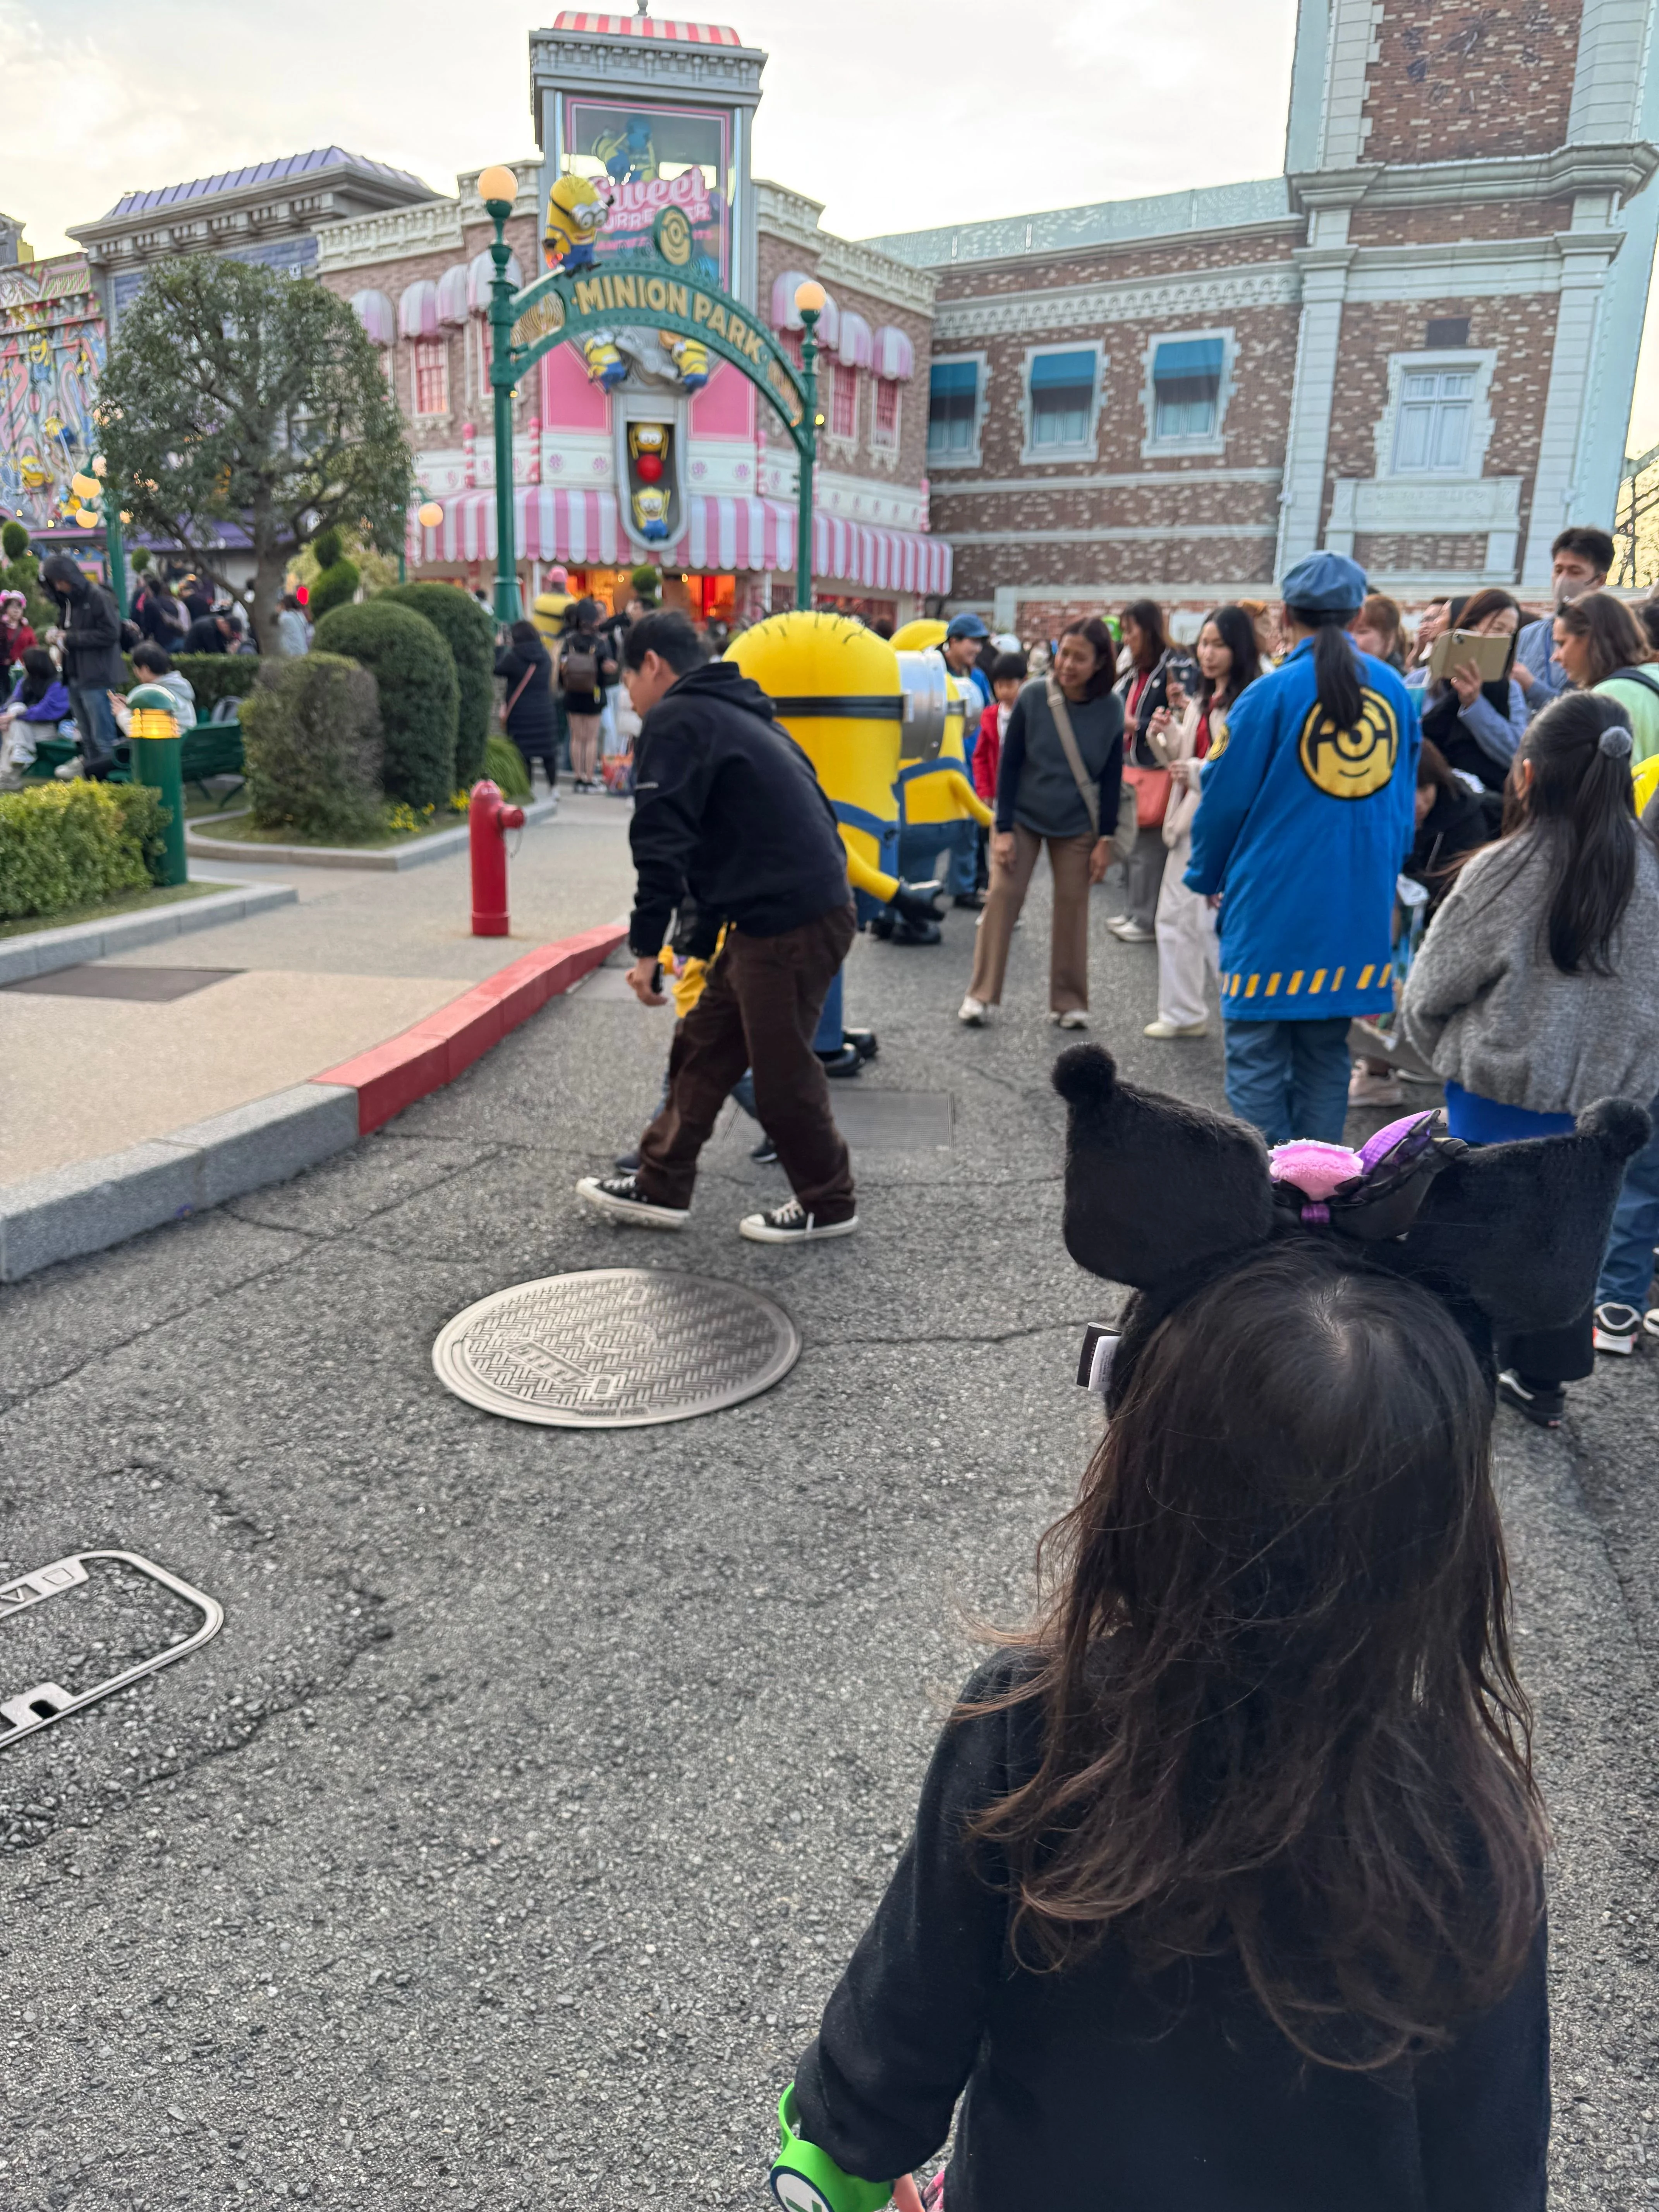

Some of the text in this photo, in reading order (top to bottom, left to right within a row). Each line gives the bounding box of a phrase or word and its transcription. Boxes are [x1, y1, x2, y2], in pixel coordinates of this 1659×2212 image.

[589, 167, 709, 211] Sweet
[575, 275, 764, 365] MINION PARK
